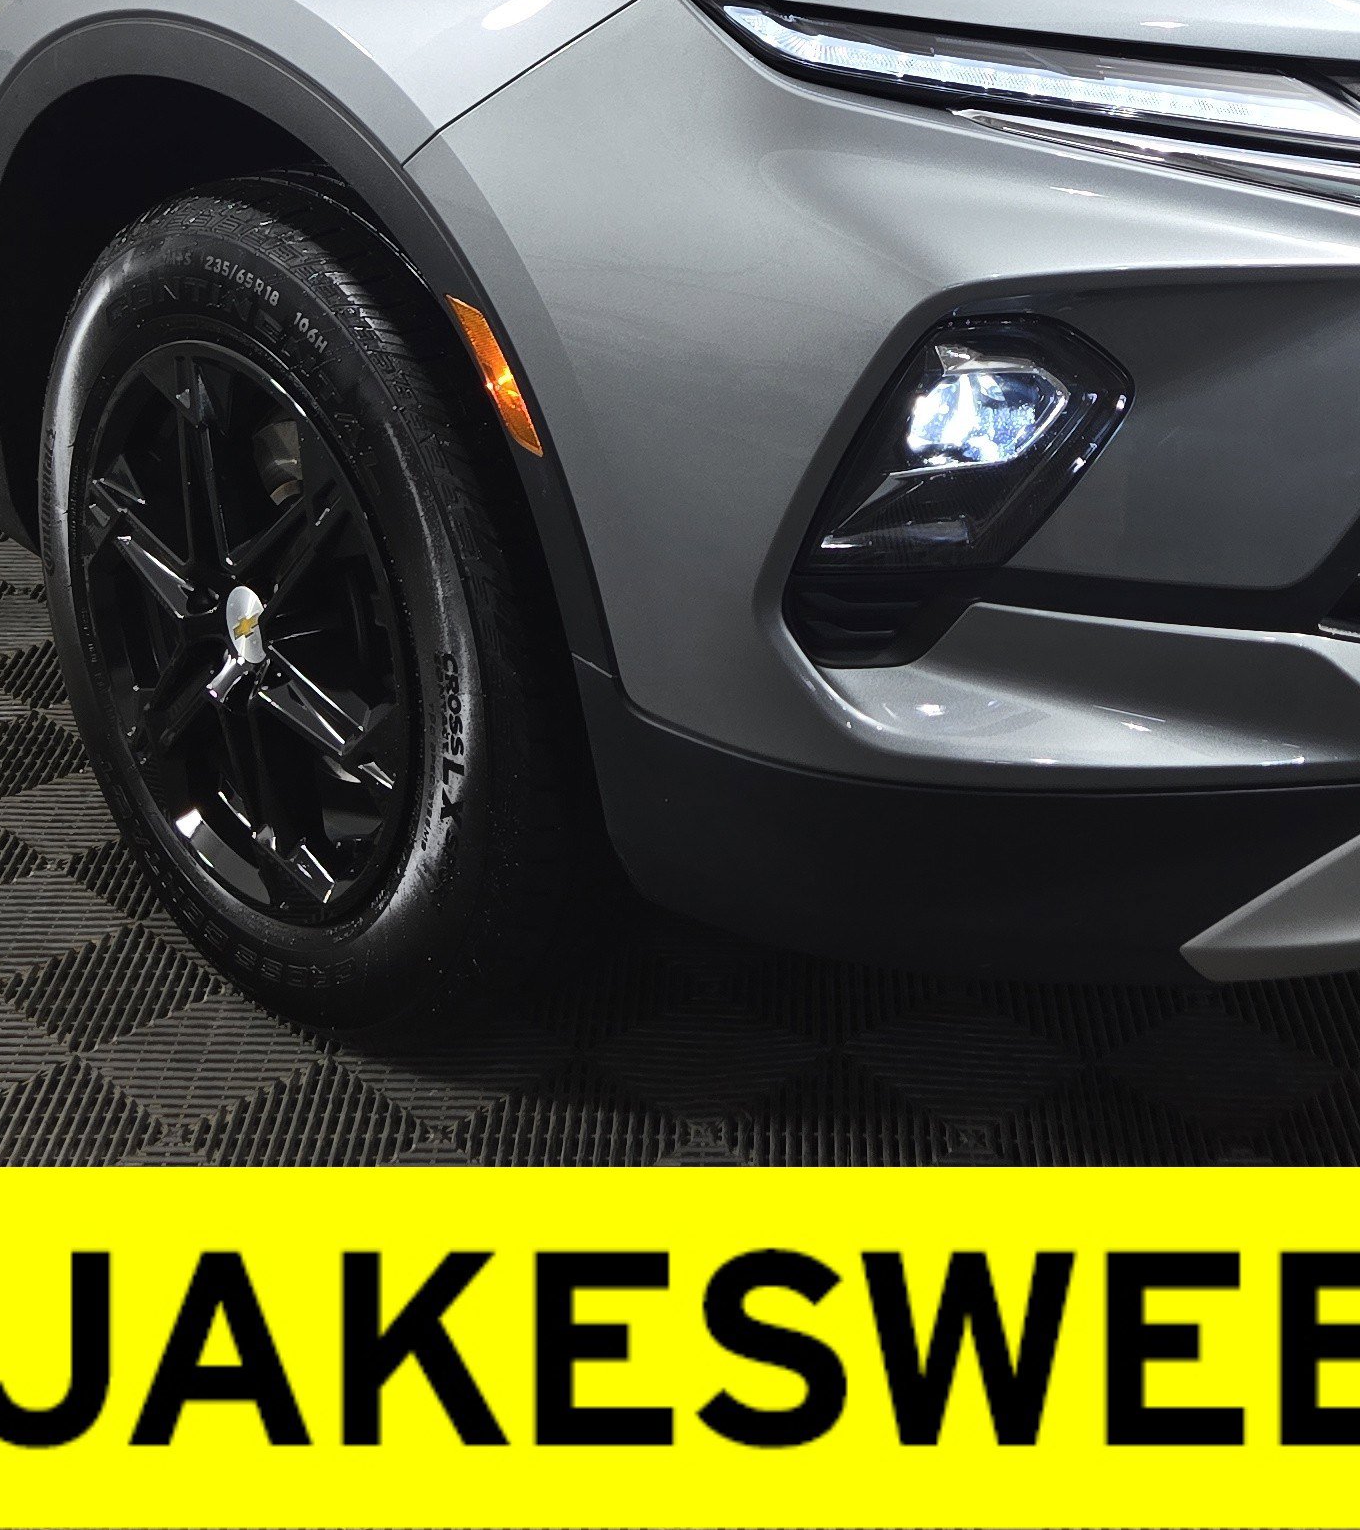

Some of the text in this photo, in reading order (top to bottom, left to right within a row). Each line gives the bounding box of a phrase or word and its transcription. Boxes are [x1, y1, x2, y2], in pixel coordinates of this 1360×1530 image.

[204, 255, 281, 307] 235/65R18
[293, 311, 329, 354] 106H
[442, 653, 465, 756] CROSS
[440, 756, 466, 829] LX
